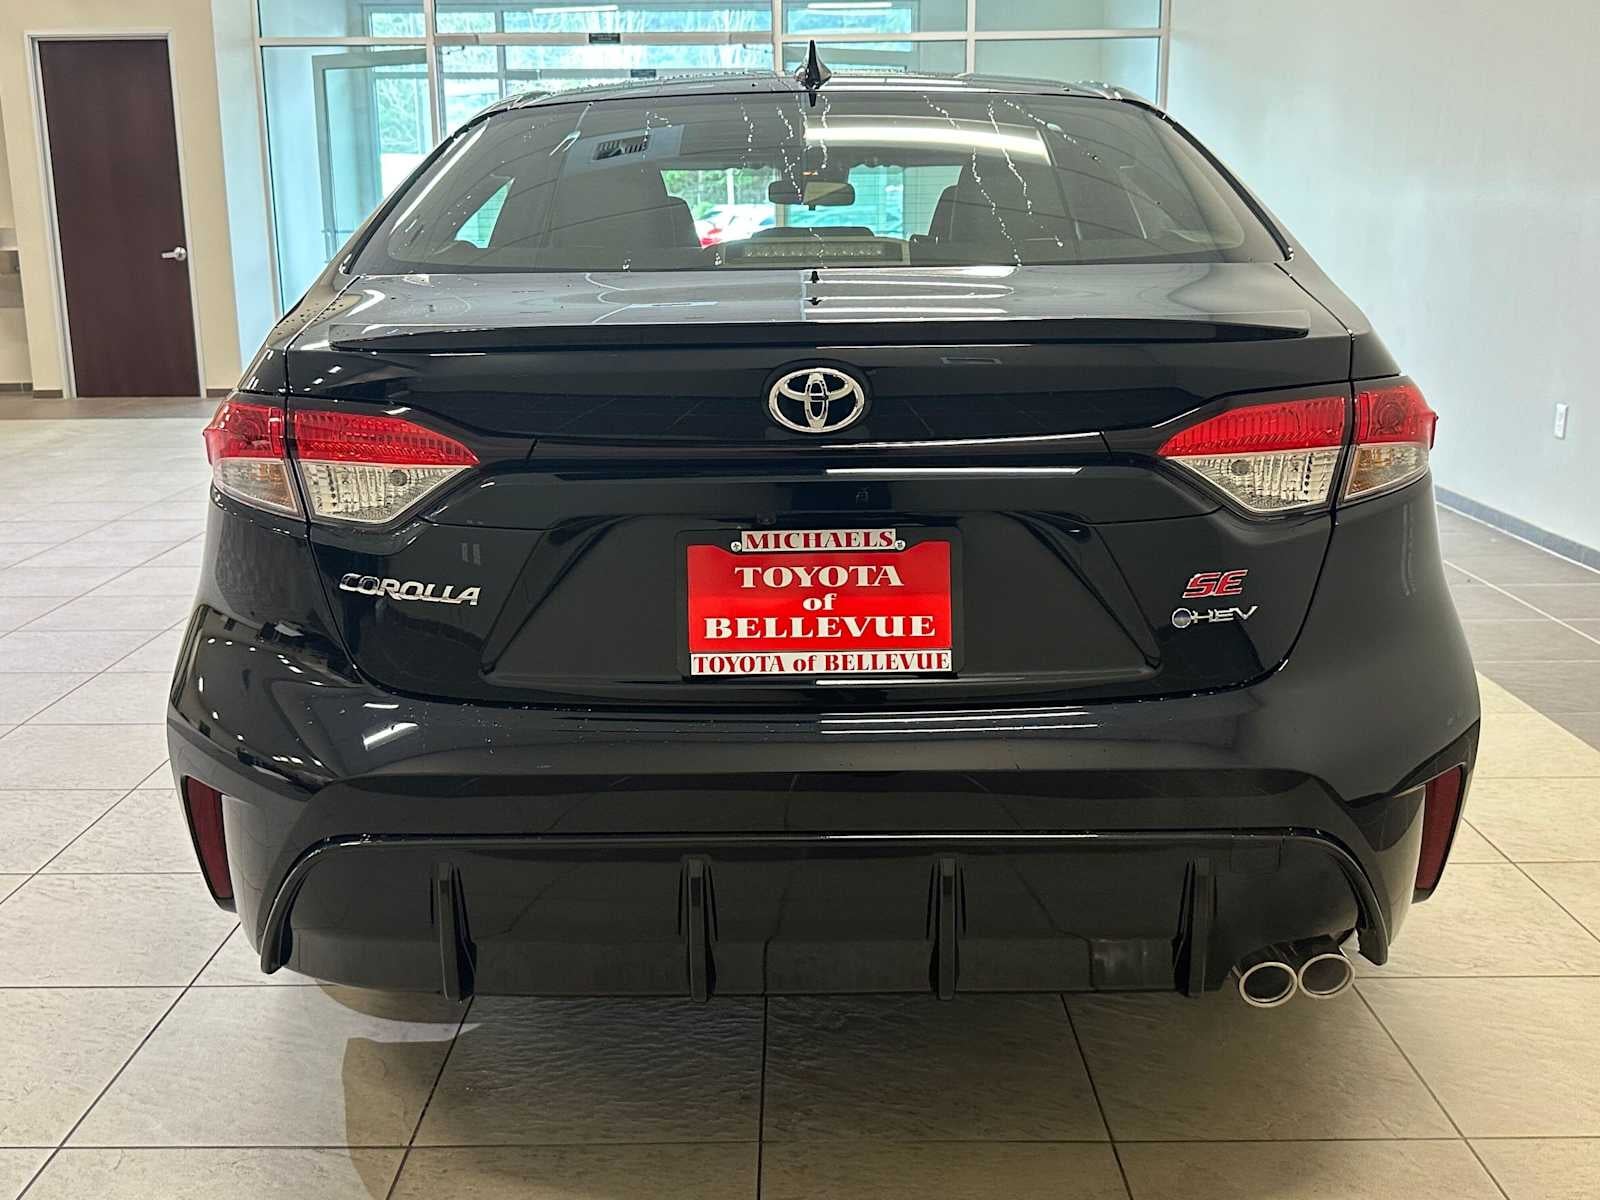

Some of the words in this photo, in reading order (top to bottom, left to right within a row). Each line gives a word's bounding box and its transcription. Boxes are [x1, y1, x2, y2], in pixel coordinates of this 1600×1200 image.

[746, 531, 893, 549] MICHAELS
[734, 565, 904, 588] TOYOTA
[1182, 569, 1248, 598] SE
[339, 573, 481, 605] COROLLA
[803, 593, 837, 611] of
[704, 616, 936, 639] BELLEVUE
[694, 654, 785, 673] TOYOTA
[793, 654, 817, 672] of
[824, 652, 950, 672] BELLEVUE
